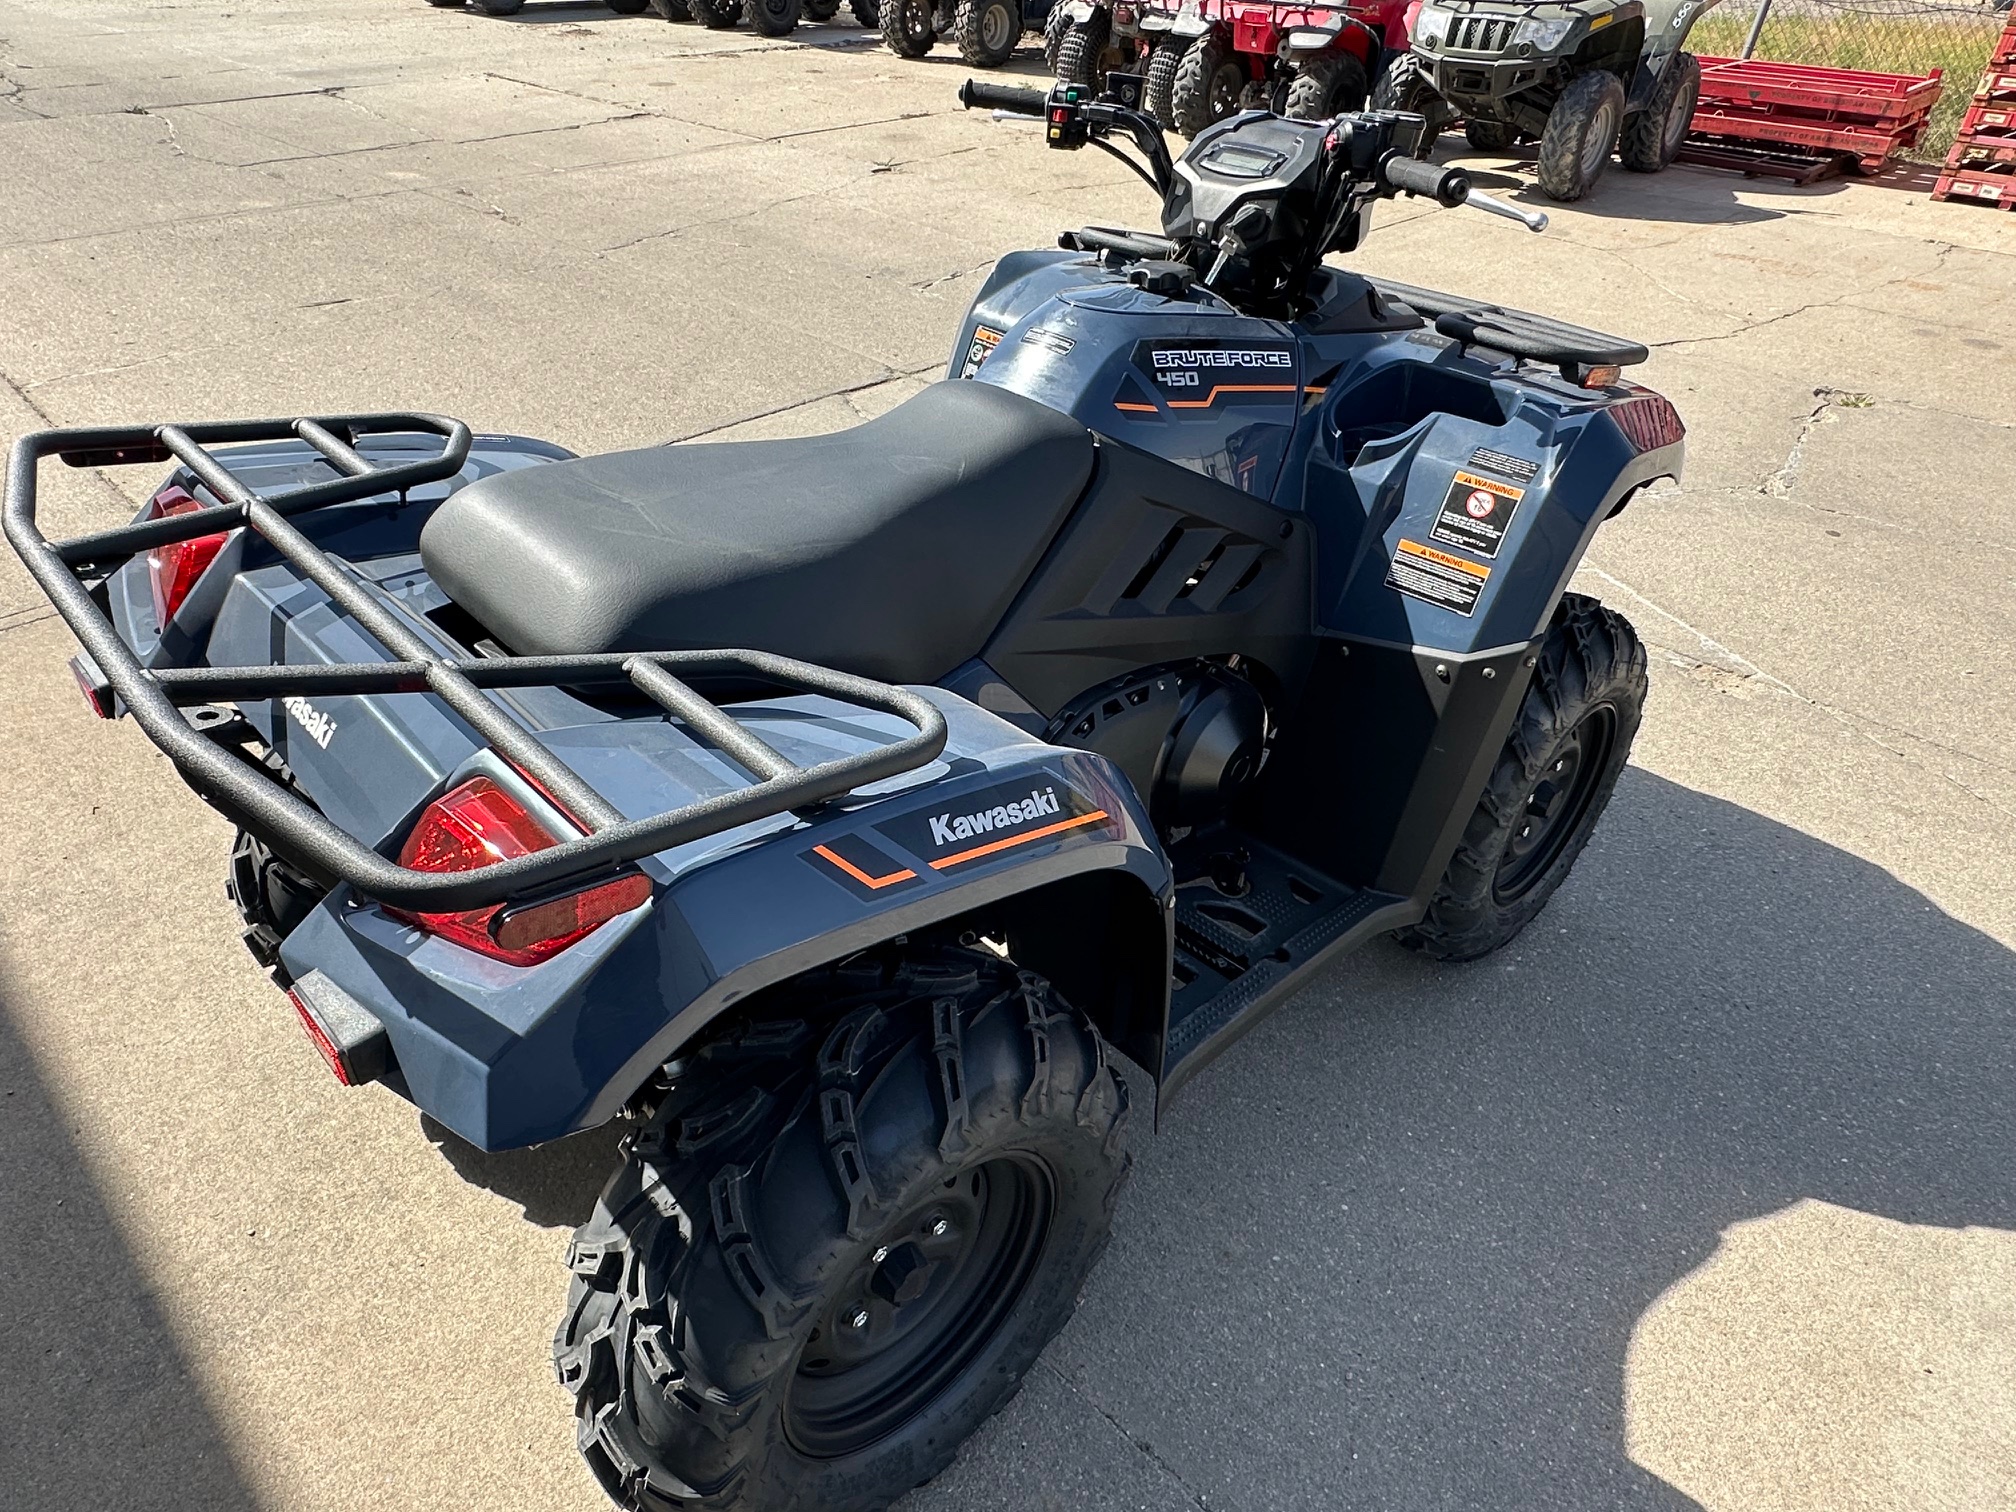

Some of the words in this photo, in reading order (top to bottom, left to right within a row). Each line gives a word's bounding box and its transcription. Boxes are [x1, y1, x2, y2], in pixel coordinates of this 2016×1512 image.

[1156, 371, 1200, 386] 450
[1474, 478, 1515, 496] WARNING
[1429, 550, 1464, 568] WARNING
[928, 787, 1060, 846] Kawasaki
